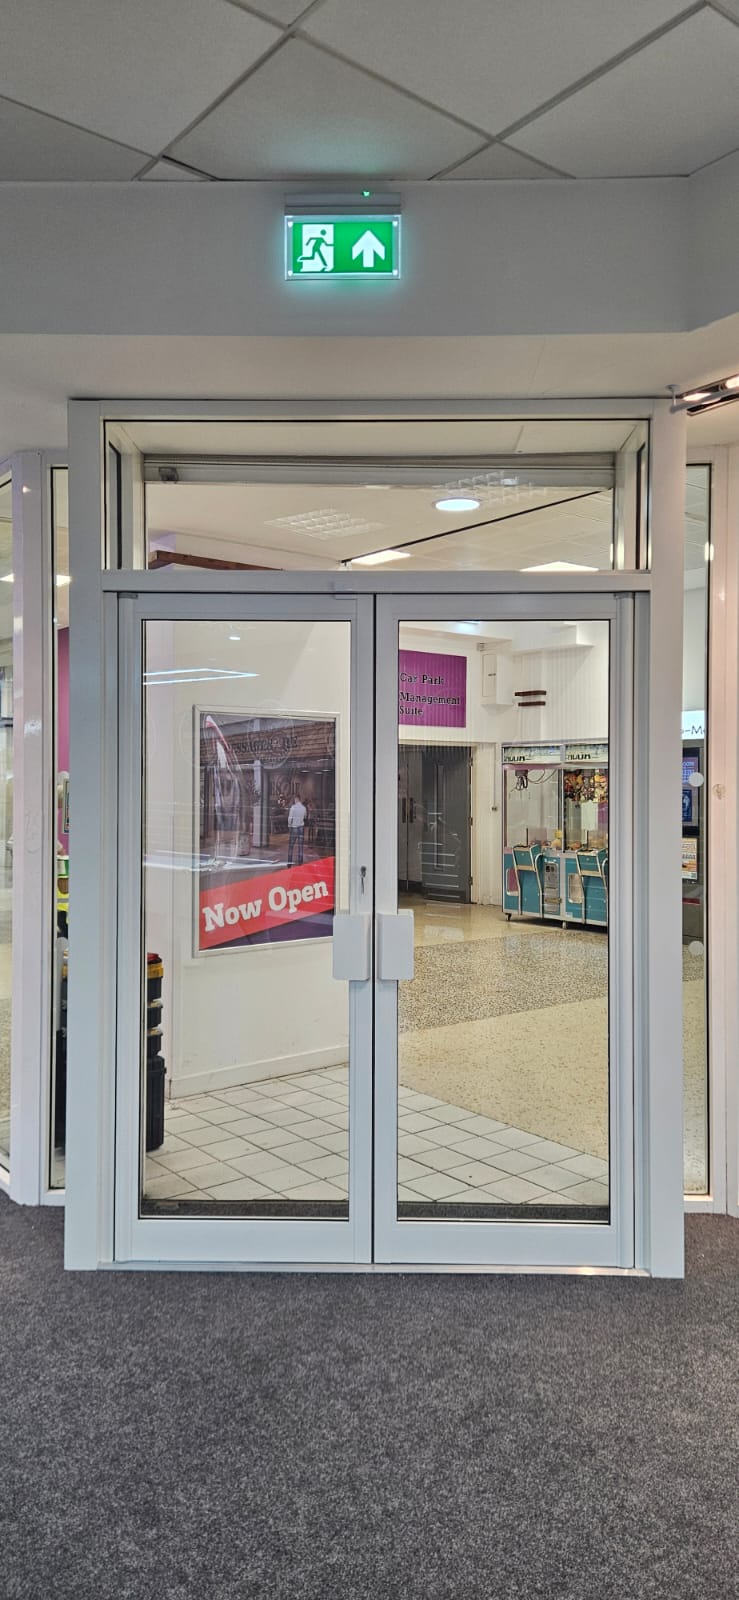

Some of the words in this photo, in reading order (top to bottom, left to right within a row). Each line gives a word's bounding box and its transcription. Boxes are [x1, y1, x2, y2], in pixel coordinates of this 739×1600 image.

[400, 672, 417, 683] Car
[422, 674, 445, 685] Park
[400, 691, 460, 705] Management
[400, 705, 423, 716] Suite
[202, 902, 263, 932] Now
[268, 881, 329, 914] Open
